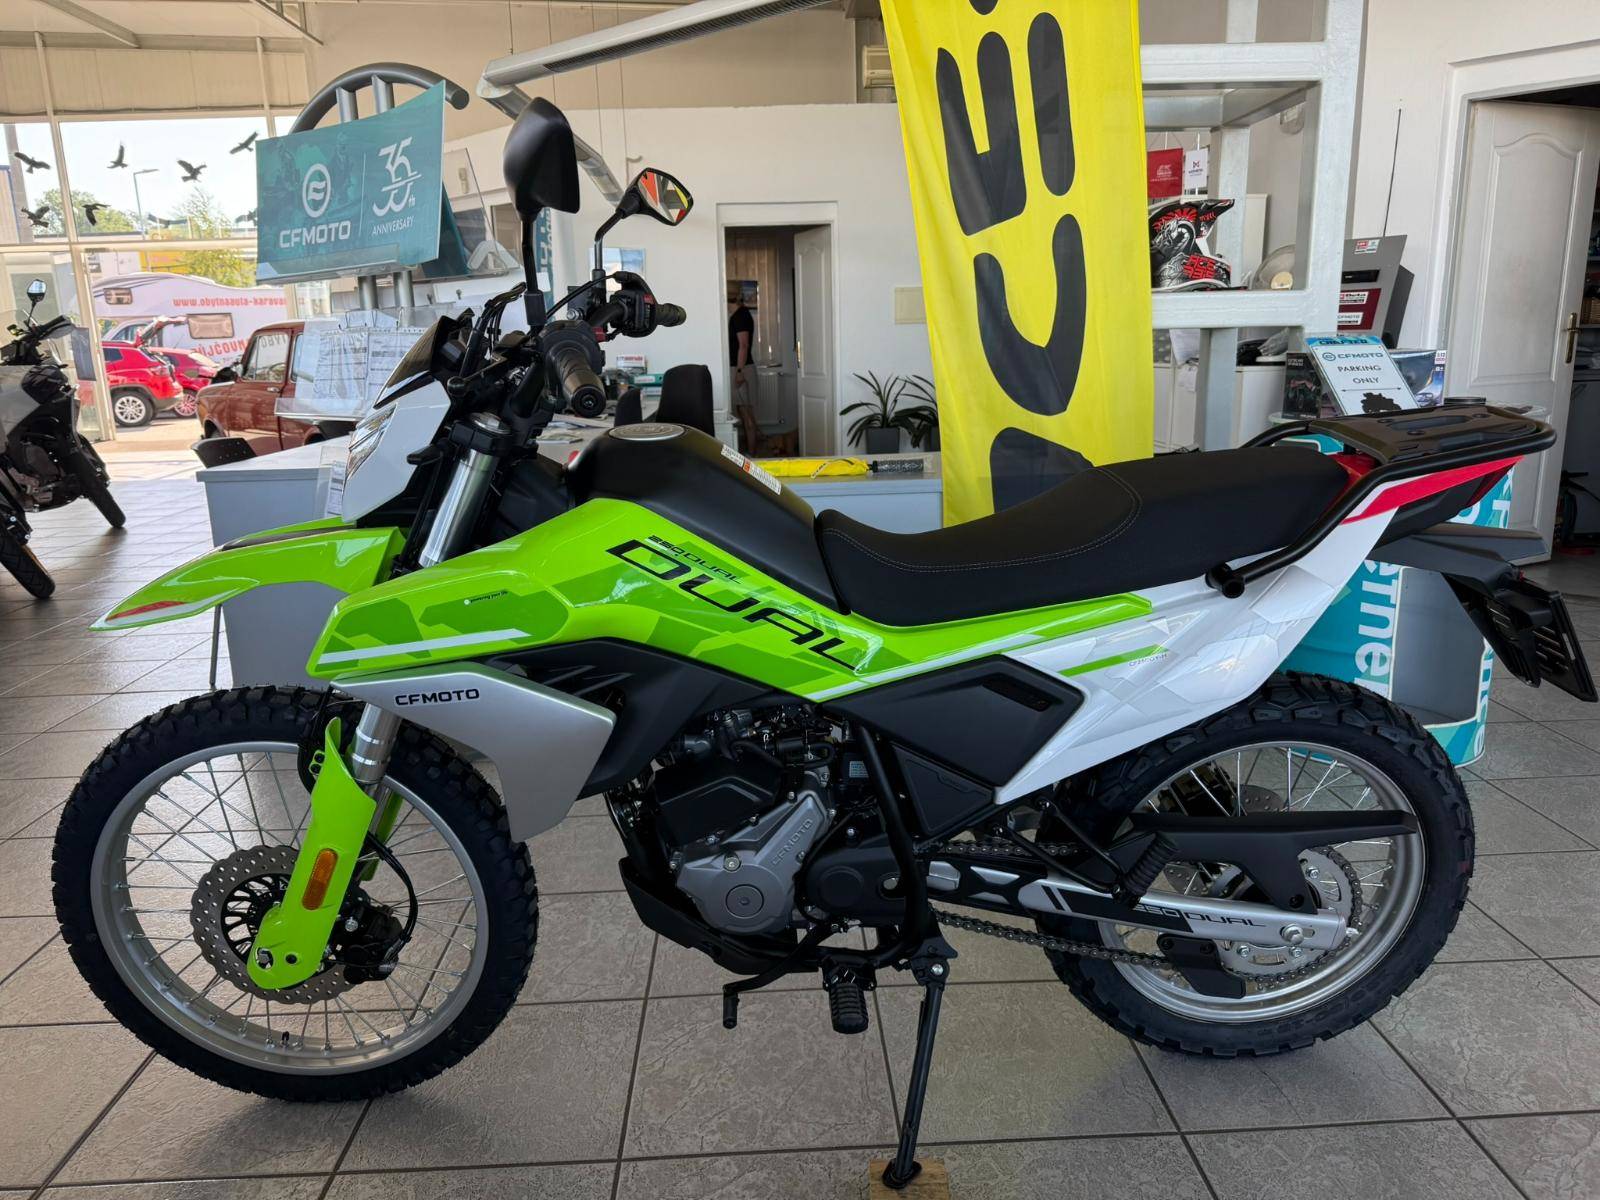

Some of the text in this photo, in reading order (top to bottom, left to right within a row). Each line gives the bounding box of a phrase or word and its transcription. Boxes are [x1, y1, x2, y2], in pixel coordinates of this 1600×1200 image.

[279, 220, 351, 249] CFMOTO
[371, 215, 415, 237] ANNIVERSARY
[1337, 365, 1382, 373] PARKING
[605, 539, 859, 672] DUAL
[394, 687, 480, 706] CFMOTO
[772, 818, 813, 865] CFMOTO
[1183, 911, 1267, 928] DUAL
